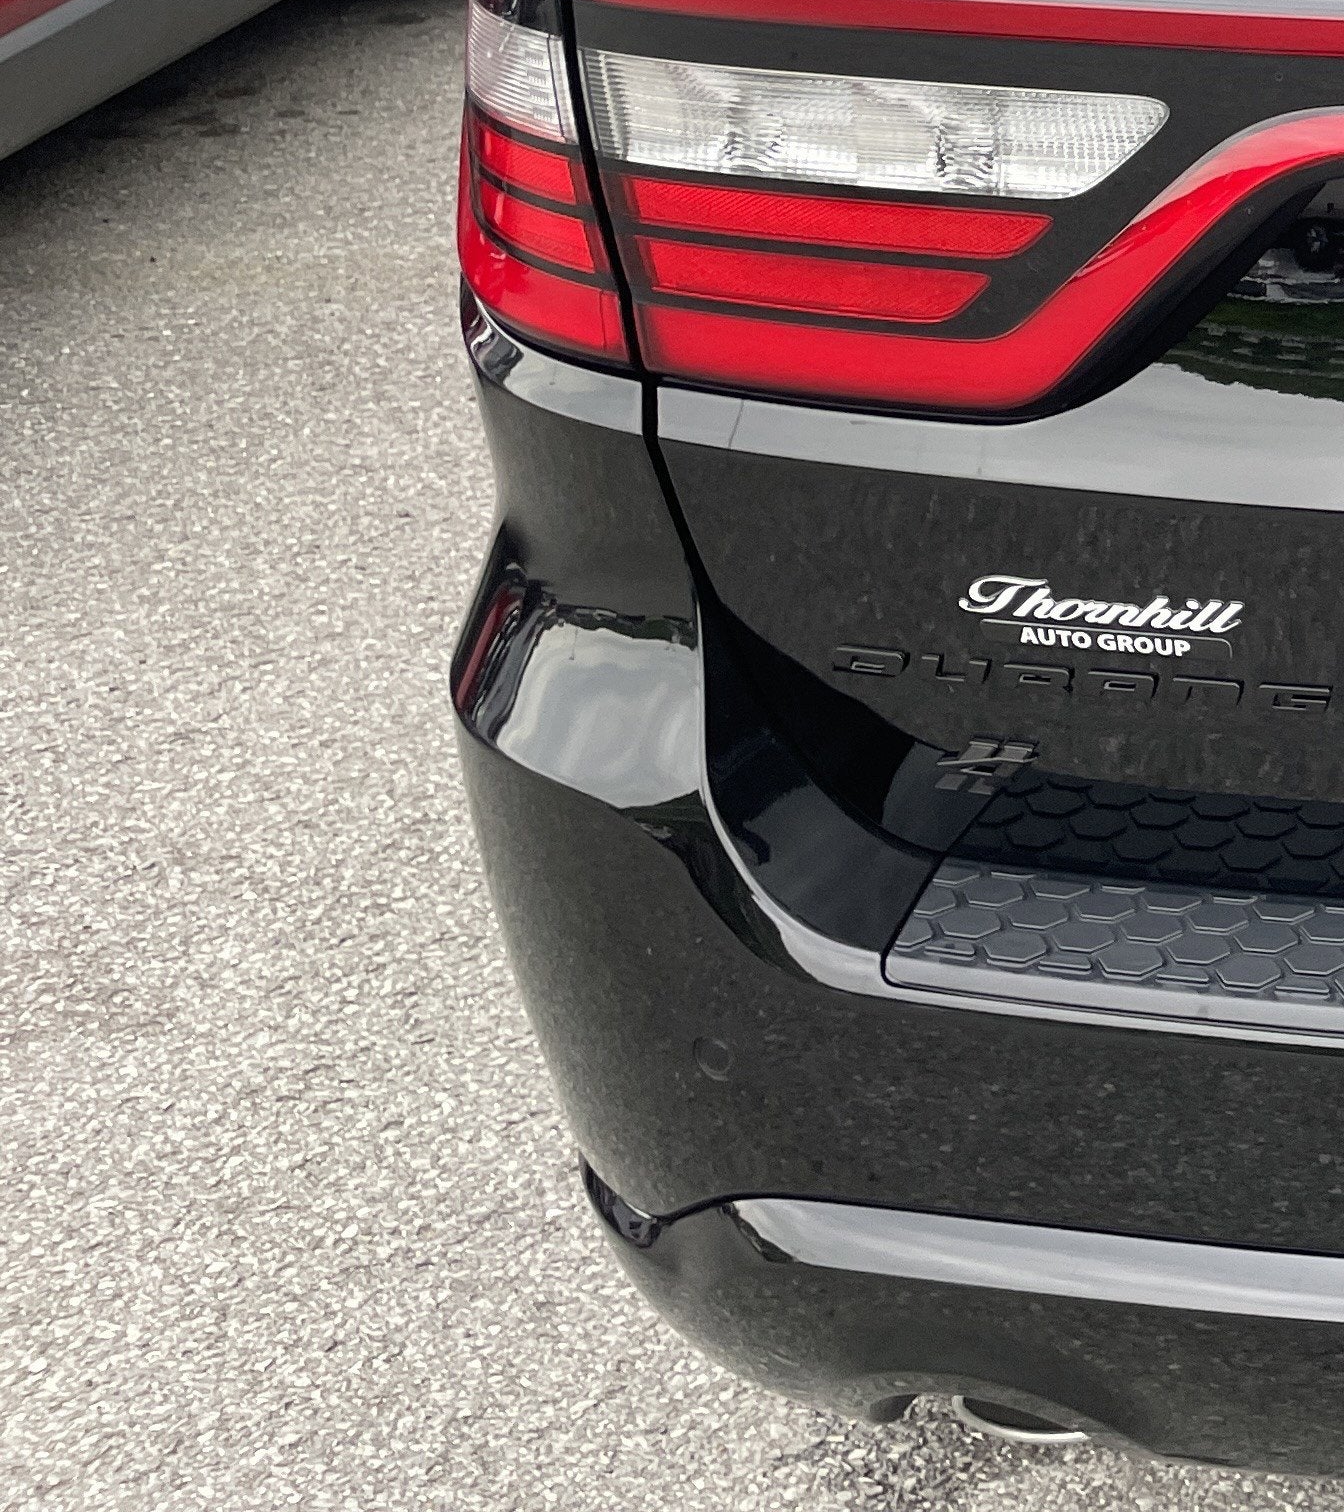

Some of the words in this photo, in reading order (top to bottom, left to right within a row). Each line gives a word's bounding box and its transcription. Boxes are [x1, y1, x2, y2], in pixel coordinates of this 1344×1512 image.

[959, 574, 1245, 634] Thornhill
[1019, 626, 1093, 649] AUTO
[1096, 633, 1191, 657] GROUP
